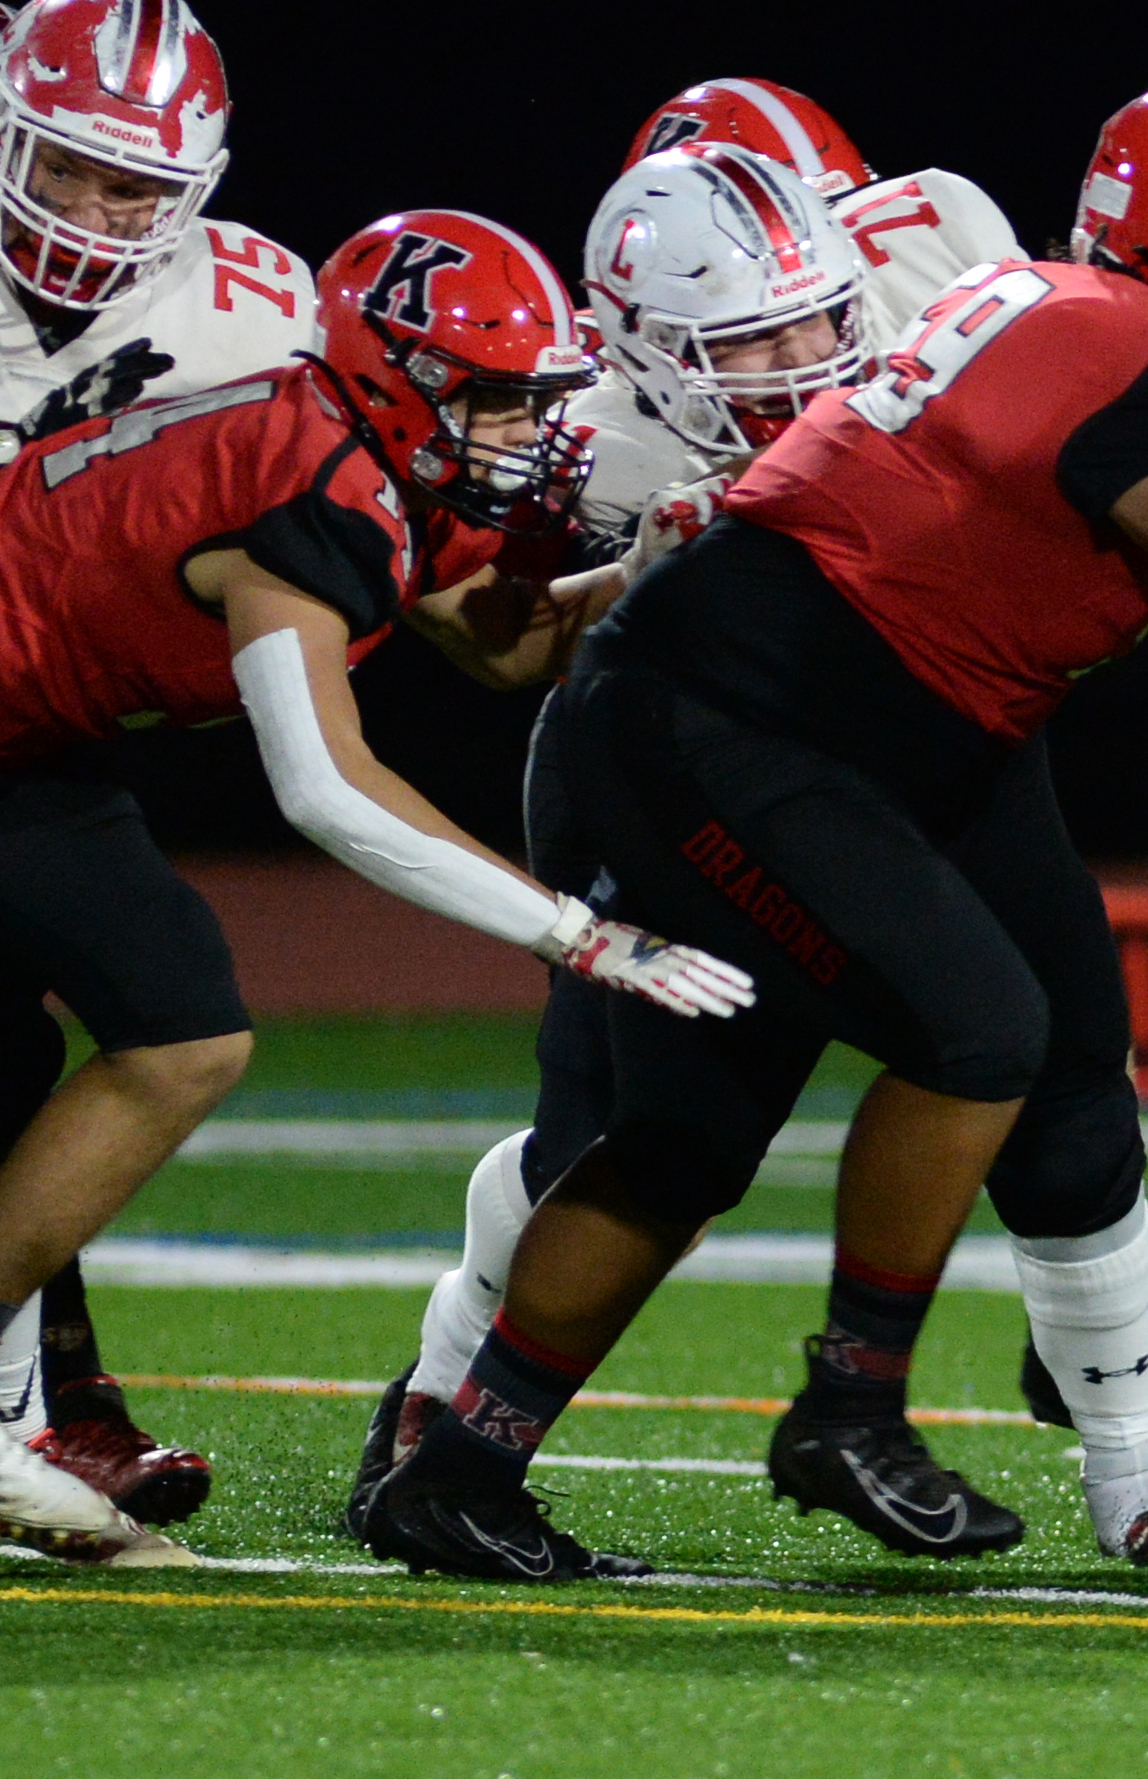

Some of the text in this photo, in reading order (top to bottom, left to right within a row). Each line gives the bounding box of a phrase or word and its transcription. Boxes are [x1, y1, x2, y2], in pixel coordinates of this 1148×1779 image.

[92, 121, 153, 148] Riddell
[206, 226, 296, 319] 75
[359, 231, 473, 333] K
[771, 271, 826, 298] Riddell
[680, 819, 849, 987] DRAGONS
[462, 1387, 540, 1451] K
